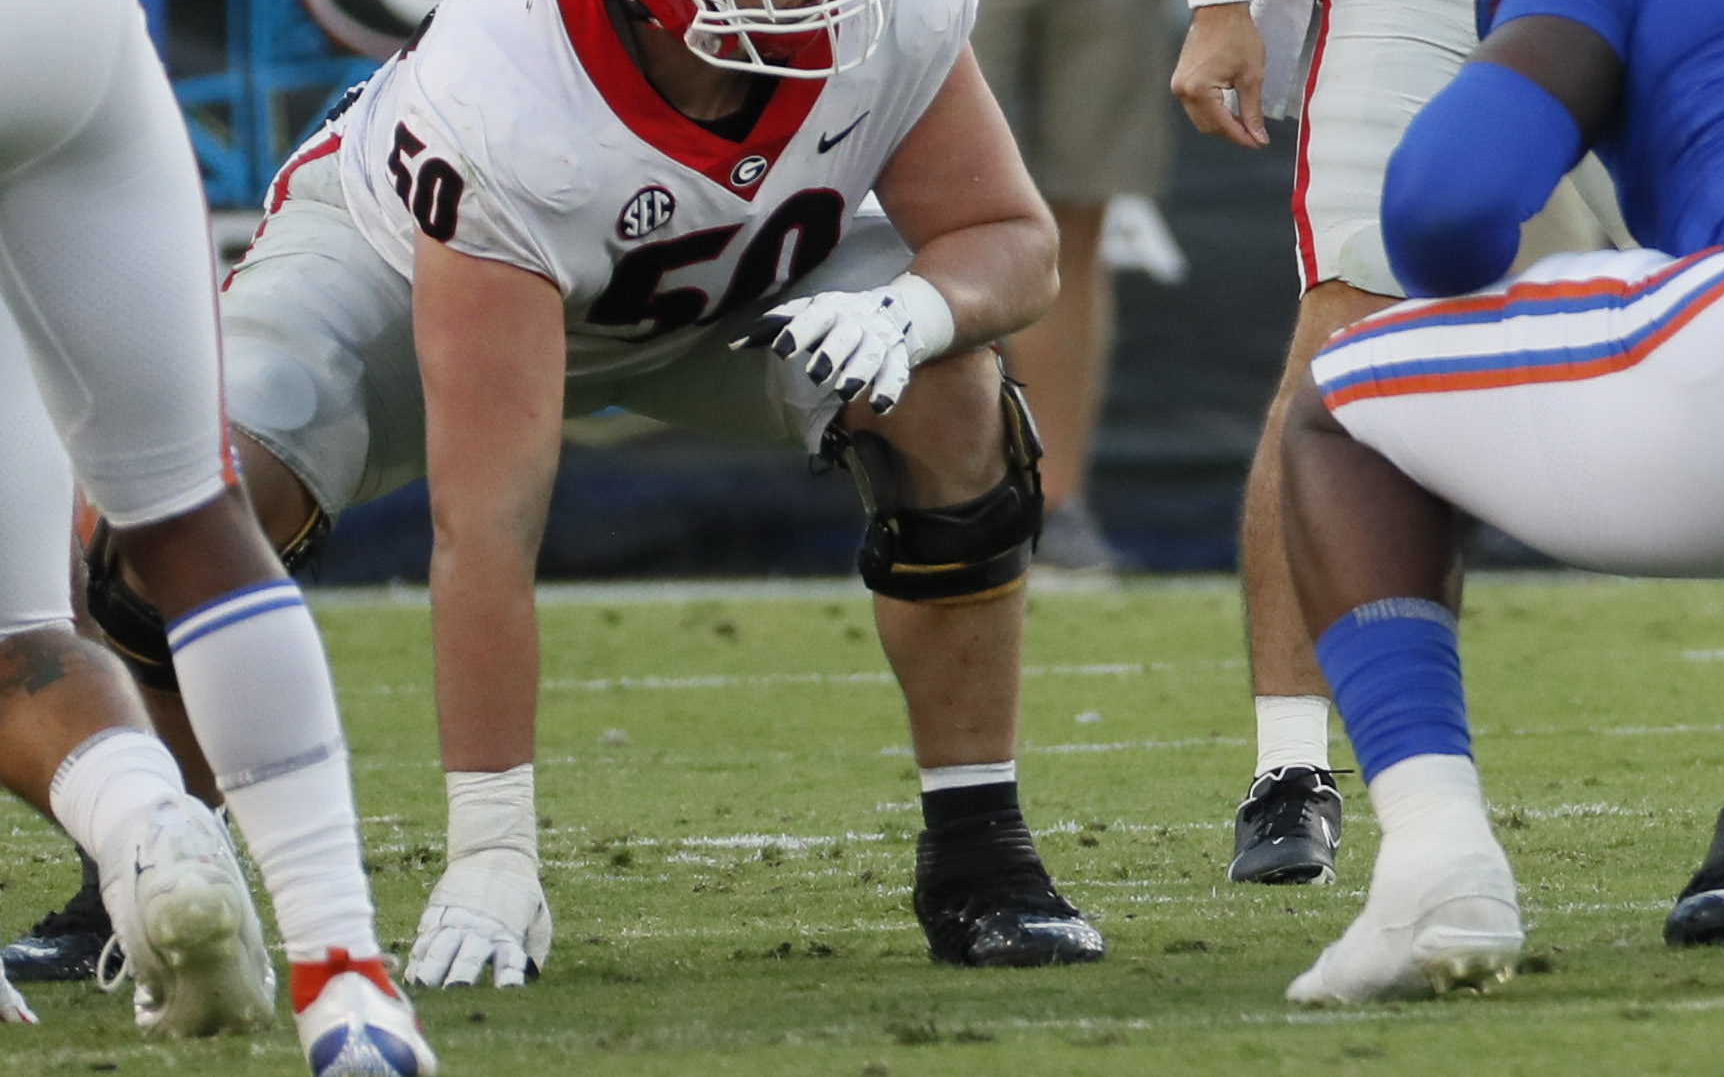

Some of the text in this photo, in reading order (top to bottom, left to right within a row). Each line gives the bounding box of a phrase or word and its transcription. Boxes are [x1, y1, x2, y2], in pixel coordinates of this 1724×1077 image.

[387, 120, 464, 243] 50
[621, 189, 673, 238] SEC
[734, 157, 767, 185] G
[585, 187, 845, 329] 50
